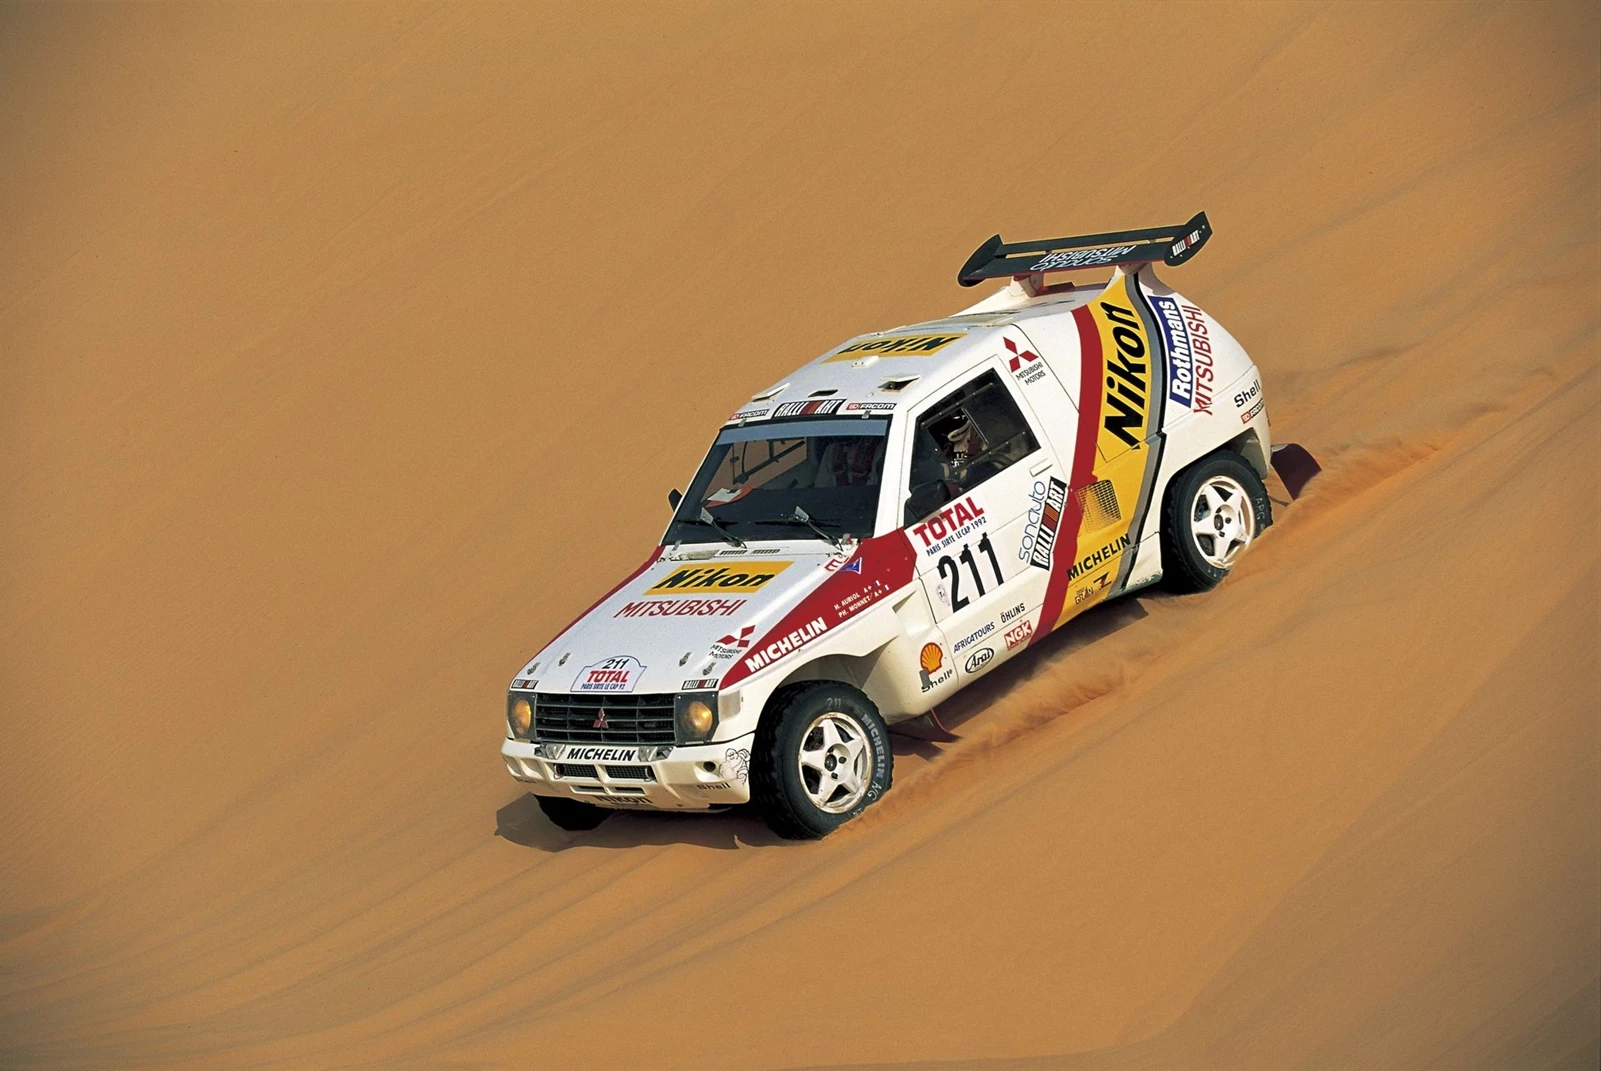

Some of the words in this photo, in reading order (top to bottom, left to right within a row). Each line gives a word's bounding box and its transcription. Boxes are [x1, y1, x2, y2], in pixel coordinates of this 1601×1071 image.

[837, 336, 961, 354] Nikon
[1158, 300, 1192, 400] Rothmans
[1015, 361, 1044, 381] MITSUBISHI
[1181, 304, 1214, 416] MITSUBISHI
[1024, 369, 1046, 386] MOTORS
[1100, 301, 1147, 451] Nikon
[1233, 379, 1261, 408] Shell
[773, 401, 808, 418] RALLI
[813, 399, 845, 415] ART
[912, 496, 985, 548] TOTAL
[926, 543, 942, 557] PARIS
[941, 534, 956, 548] SIRTE
[970, 516, 987, 530] 1992
[1018, 480, 1046, 564] sonauto
[1032, 523, 1055, 567] RALLI
[1045, 480, 1065, 513] ART
[1066, 533, 1131, 581] MICHELIN
[651, 568, 775, 589] Nikon
[936, 532, 1005, 614] 211
[612, 599, 748, 618] MITSUBISHI
[999, 602, 1026, 624] ÖHLINS
[744, 616, 828, 673] MICHELIN
[953, 621, 996, 653] AFRICATOURS
[1005, 621, 1031, 647] NGK
[601, 658, 630, 669] 211
[968, 649, 991, 671] Arai
[587, 670, 630, 682] TOTAL
[566, 748, 636, 762] MICHELIN
[861, 713, 885, 779] MICHELIN
